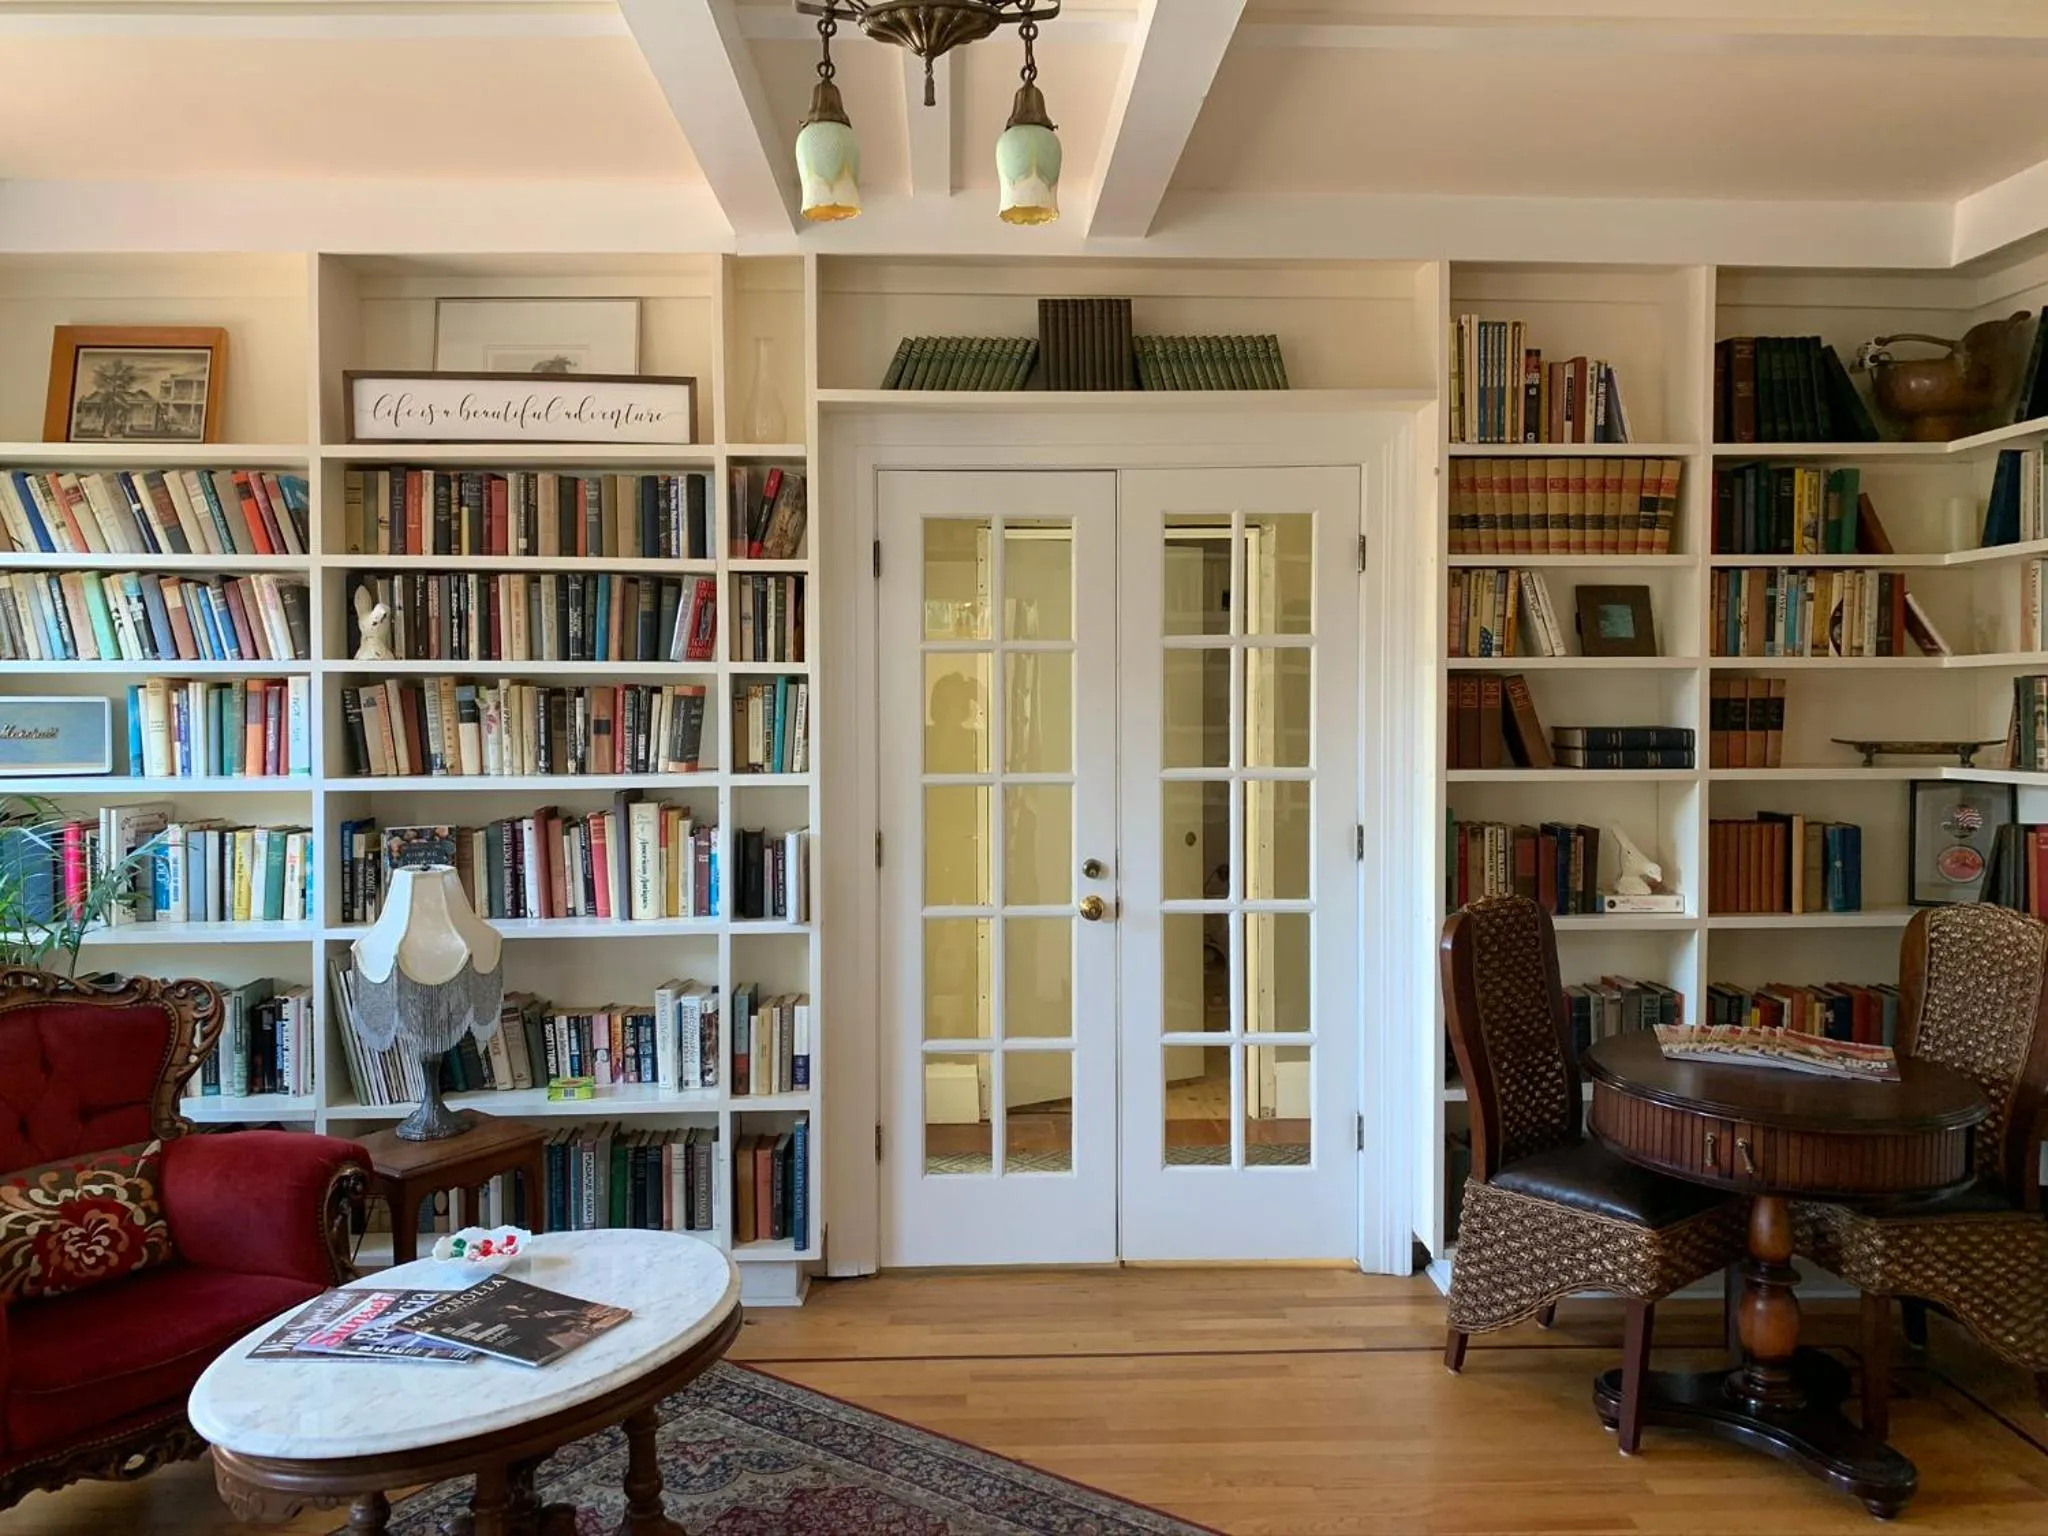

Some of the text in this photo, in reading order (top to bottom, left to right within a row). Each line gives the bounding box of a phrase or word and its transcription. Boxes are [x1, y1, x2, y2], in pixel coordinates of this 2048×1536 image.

[419, 403, 434, 426] is
[458, 392, 563, 429] beautiful
[563, 395, 668, 430] adventure
[585, 1154, 594, 1222] MADAME SARAH
[403, 1278, 508, 1327] MAGNOLIA
